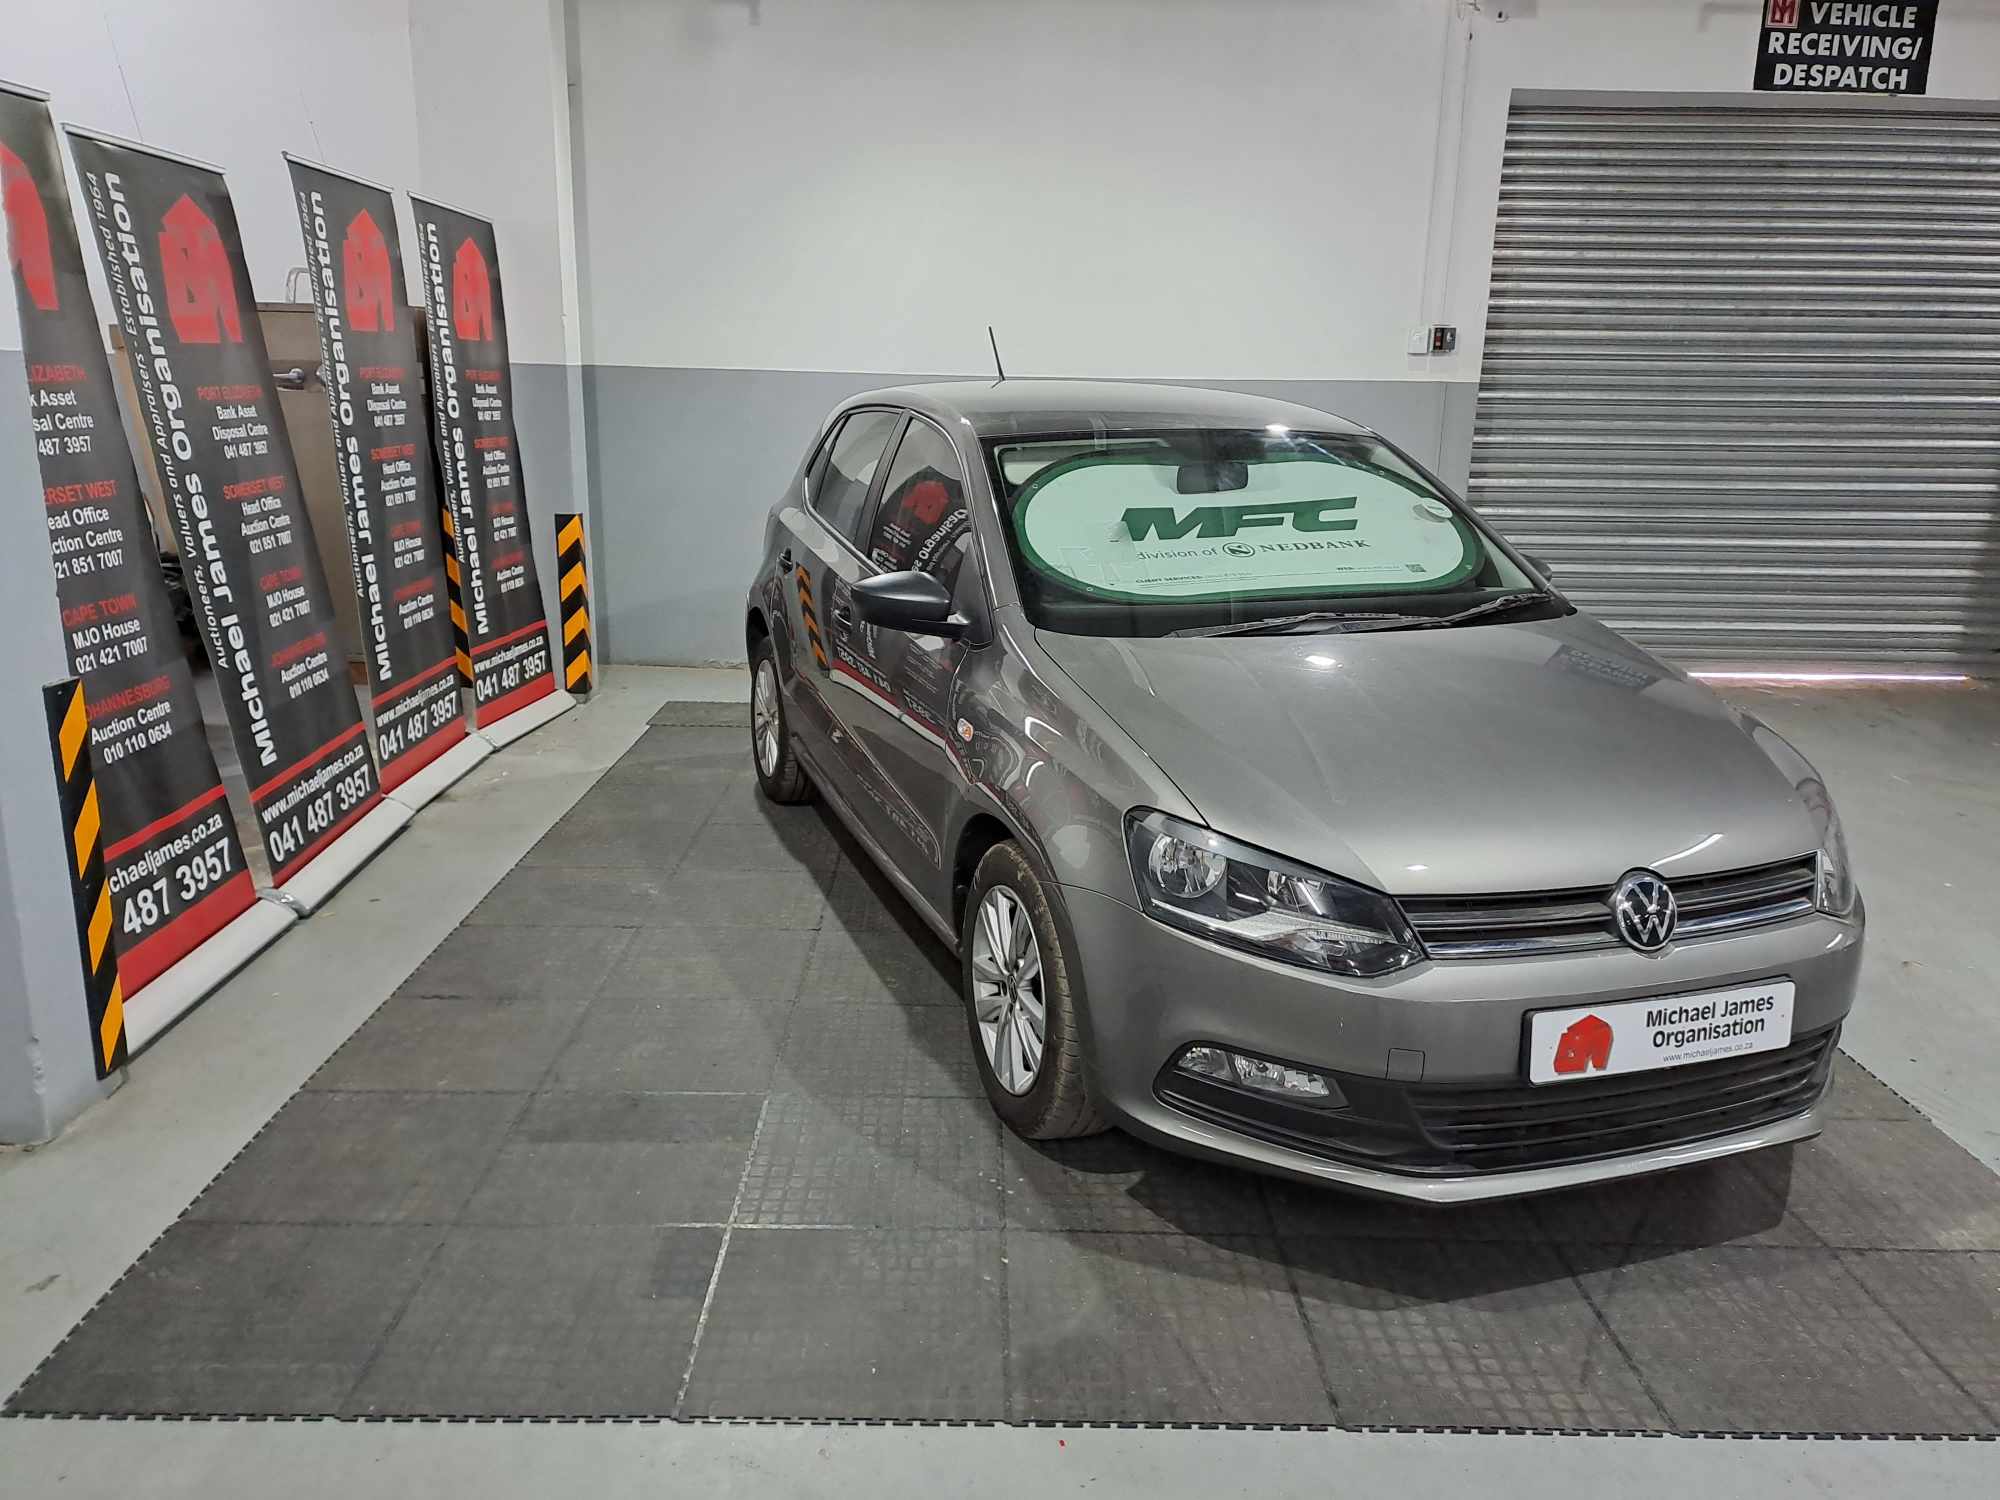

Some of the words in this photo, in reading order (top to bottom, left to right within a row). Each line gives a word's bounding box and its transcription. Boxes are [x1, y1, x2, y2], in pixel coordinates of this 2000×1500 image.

[1811, 2, 1918, 28] VEHICLE
[1767, 32, 1923, 60] RECEIVING/
[1773, 64, 1909, 90] DESPATCH
[105, 172, 192, 460] Organisation
[311, 192, 354, 426] Organisation
[427, 223, 459, 419] Organisation
[40, 389, 77, 406] Asset
[135, 352, 168, 450] Appraisers
[32, 413, 53, 432] sal
[54, 412, 95, 430] Centre
[38, 438, 60, 455] 487
[63, 435, 92, 454] 3957
[160, 453, 179, 488] and
[346, 436, 372, 545] James
[452, 427, 473, 520] James
[47, 511, 71, 530] ead
[72, 506, 110, 525] Office
[173, 493, 197, 558] Valuers
[184, 472, 233, 603] James
[1121, 496, 1358, 541] MFC
[52, 535, 84, 555] ction
[85, 528, 123, 547] Centre
[54, 560, 70, 579] 21
[71, 554, 95, 575] 851
[96, 548, 123, 569] 7007
[1202, 547, 1218, 558] of
[1258, 539, 1372, 552] NEDBANK
[464, 527, 488, 634] Michael
[63, 603, 98, 627] CAPE
[72, 627, 100, 650] MJO
[101, 618, 141, 641] House
[194, 565, 229, 669] Auctioneers,
[361, 554, 392, 681] Michael
[75, 653, 97, 674] 021
[99, 645, 121, 667] 421
[122, 636, 148, 658] 7007
[477, 673, 498, 701] 041
[502, 663, 520, 689] 487
[523, 650, 546, 679] 3957
[221, 614, 277, 767] Michael
[90, 715, 136, 745] Auction
[137, 700, 172, 725] Centre
[103, 745, 124, 765] 010
[125, 732, 147, 753] 110
[149, 721, 172, 744] 0634
[380, 724, 404, 760] 041
[408, 709, 428, 742] 487
[431, 691, 457, 727] 3957
[262, 744, 364, 825] www.michaeljames.co.za
[270, 815, 304, 862] 041
[307, 791, 334, 833] 487
[336, 763, 371, 810] 3957
[124, 877, 170, 934] 487
[175, 837, 231, 901] 3957
[1645, 1002, 1716, 1027] Michael
[1720, 995, 1774, 1017] James
[1652, 1017, 1765, 1048] Organisation
